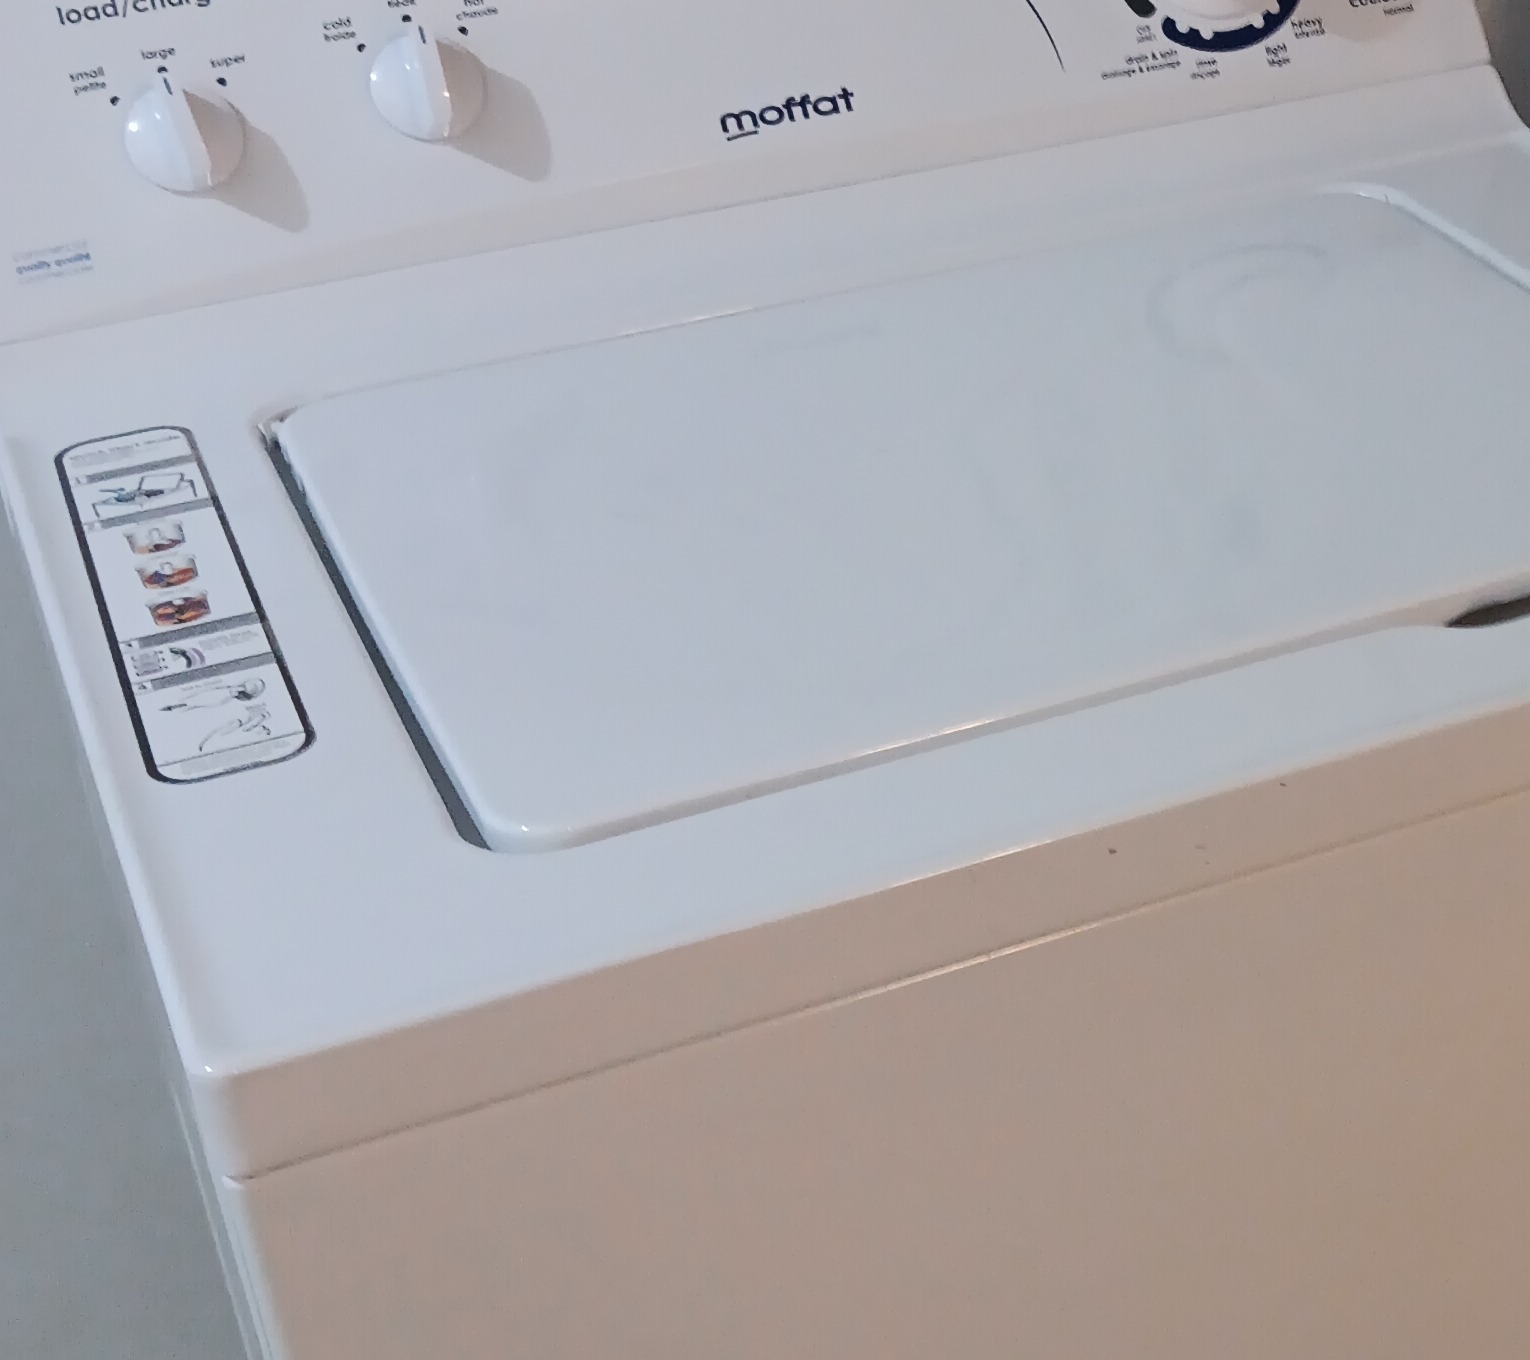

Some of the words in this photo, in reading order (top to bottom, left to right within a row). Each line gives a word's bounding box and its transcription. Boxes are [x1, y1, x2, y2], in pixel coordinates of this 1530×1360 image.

[323, 16, 352, 31] cold
[140, 46, 177, 62] large
[210, 53, 247, 69] super
[69, 66, 106, 83] small
[720, 86, 854, 138] moffat
